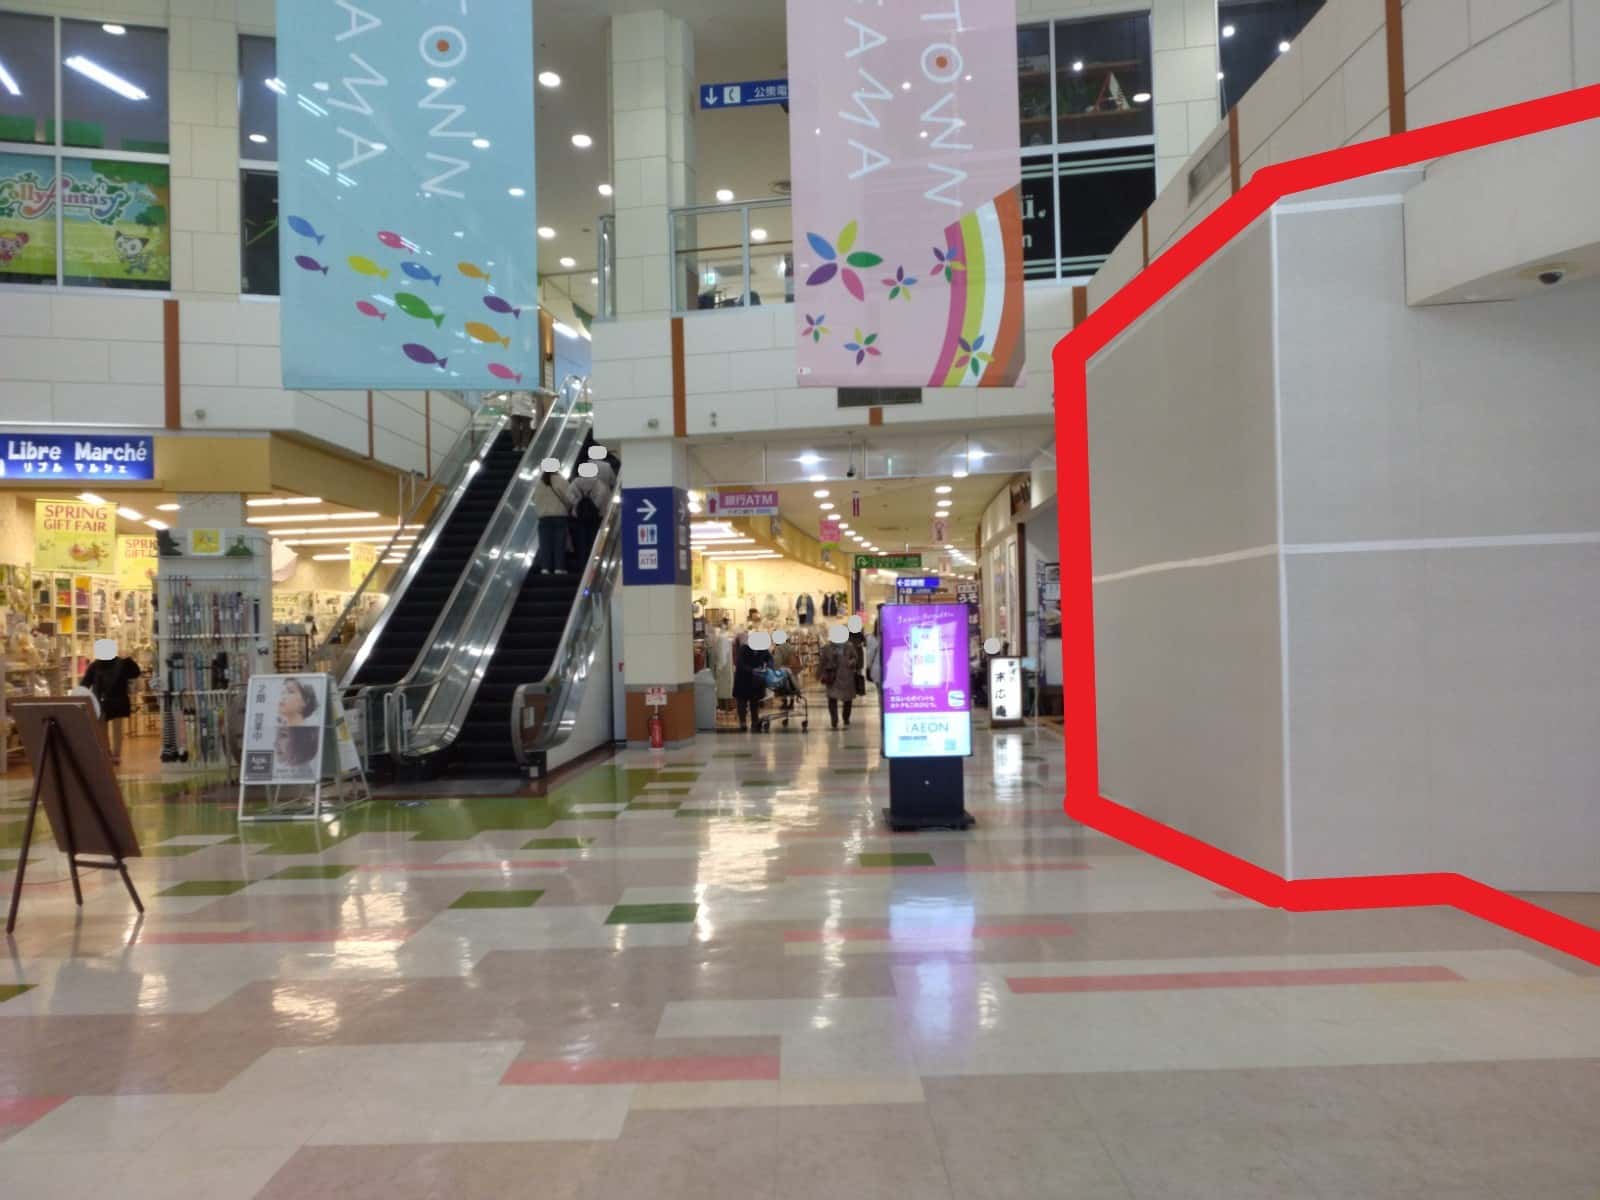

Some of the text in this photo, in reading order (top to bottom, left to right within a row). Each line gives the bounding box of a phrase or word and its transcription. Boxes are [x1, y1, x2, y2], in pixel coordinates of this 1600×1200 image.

[838, 0, 894, 180] AMA
[919, 0, 974, 207] TOWN
[8, 440, 147, 461] Libre Marché
[45, 504, 108, 520] SPRING
[43, 519, 107, 532] GIFT FAIR
